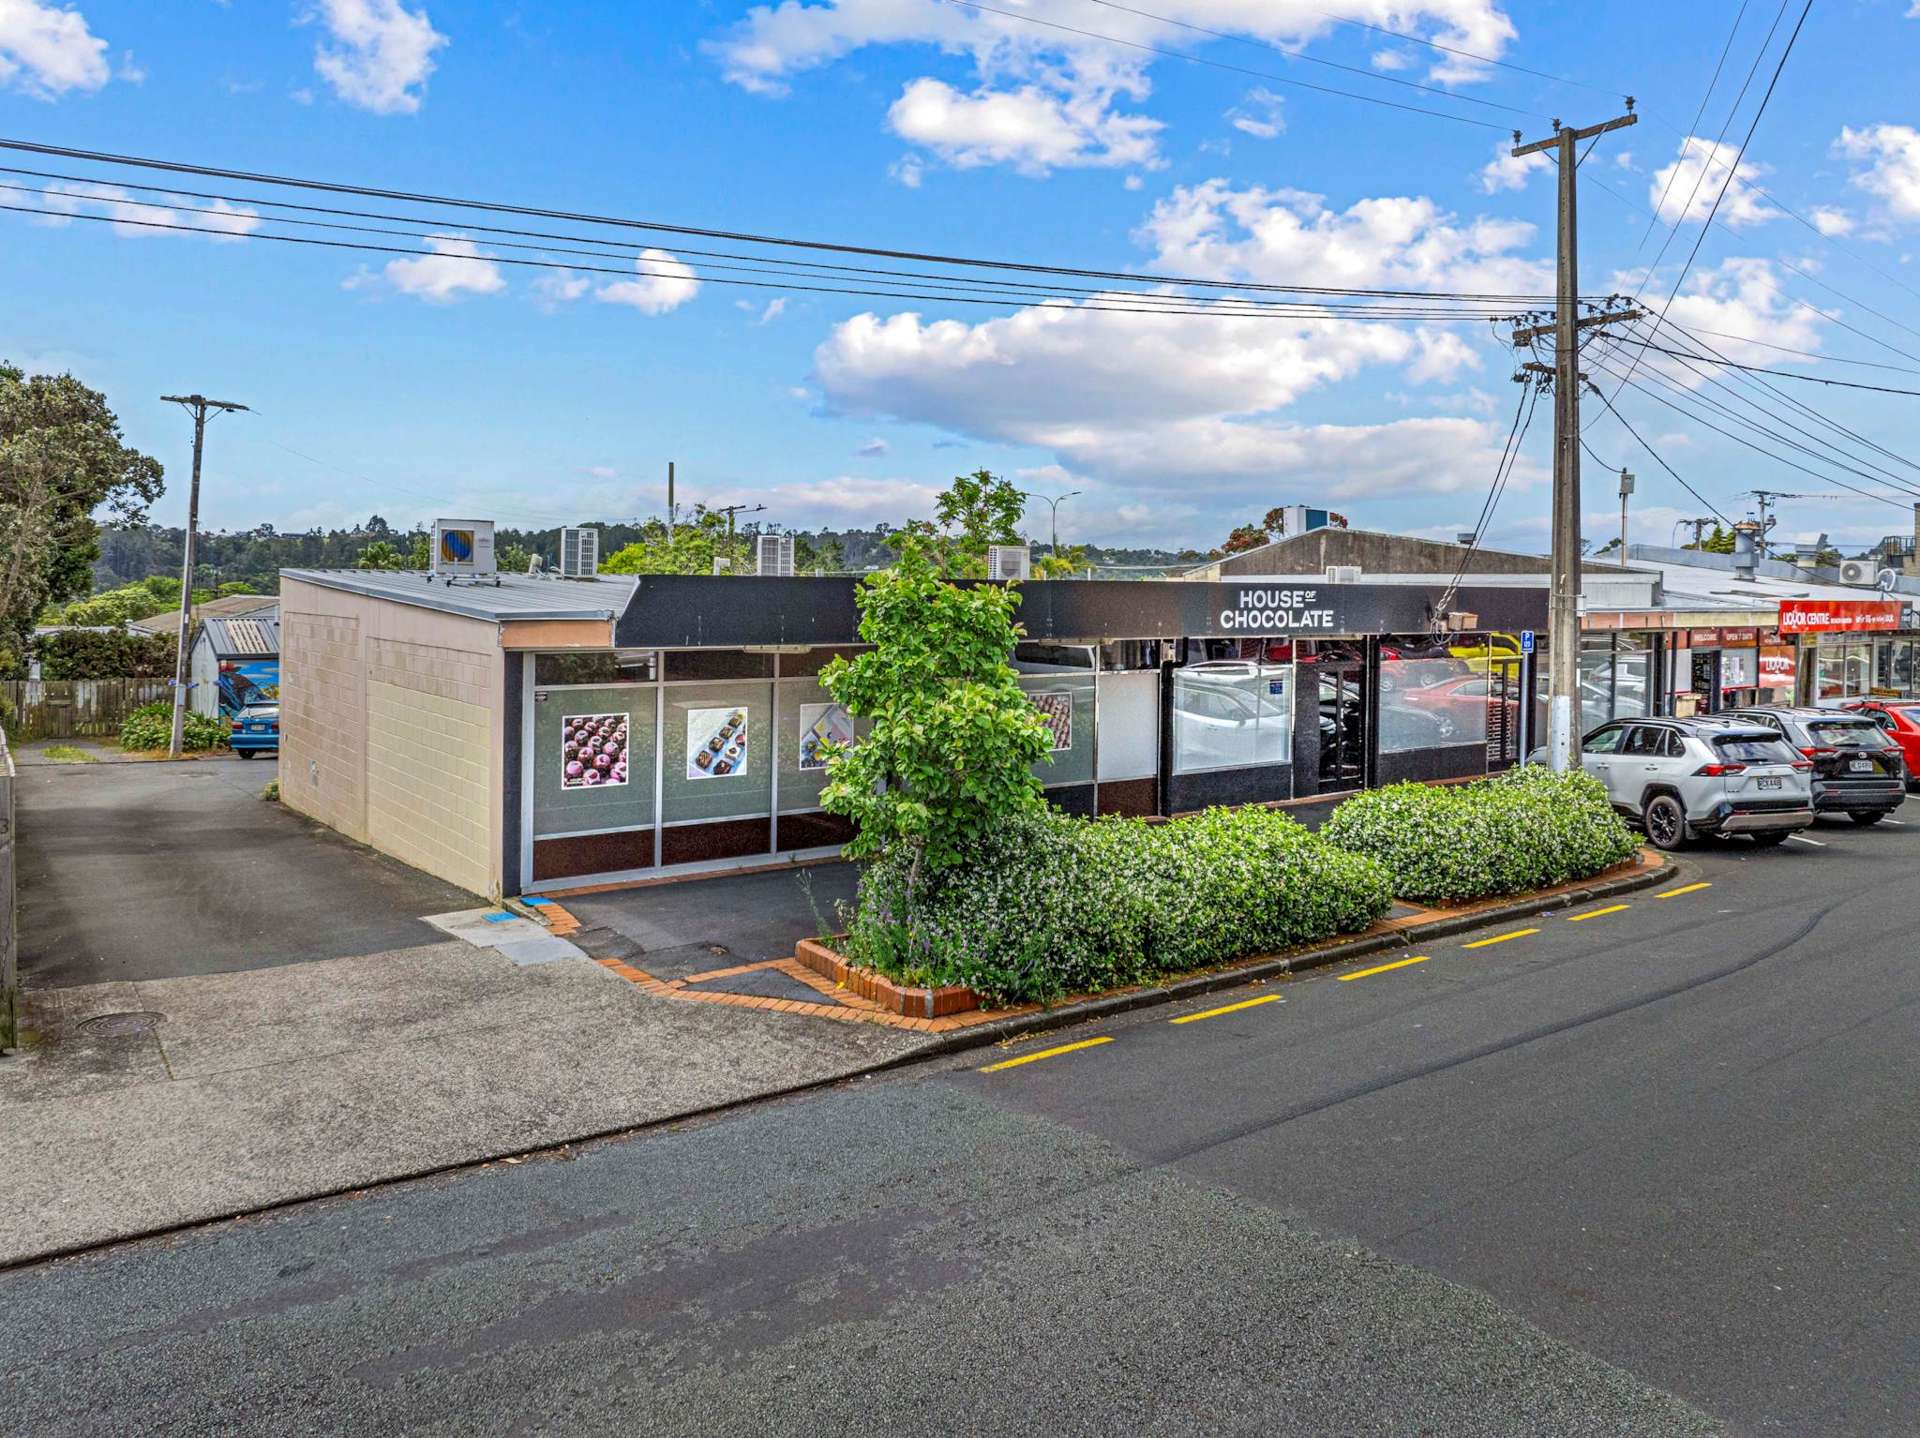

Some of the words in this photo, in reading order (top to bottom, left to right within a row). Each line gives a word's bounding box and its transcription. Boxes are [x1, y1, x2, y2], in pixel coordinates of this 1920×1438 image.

[1240, 590, 1304, 608] HOUSE
[1305, 590, 1317, 599] OF
[1220, 610, 1334, 628] CHOCOLATE
[1807, 612, 1830, 625] CENTRE
[1694, 633, 1717, 641] WELCOME
[1726, 633, 1738, 641] OPEN
